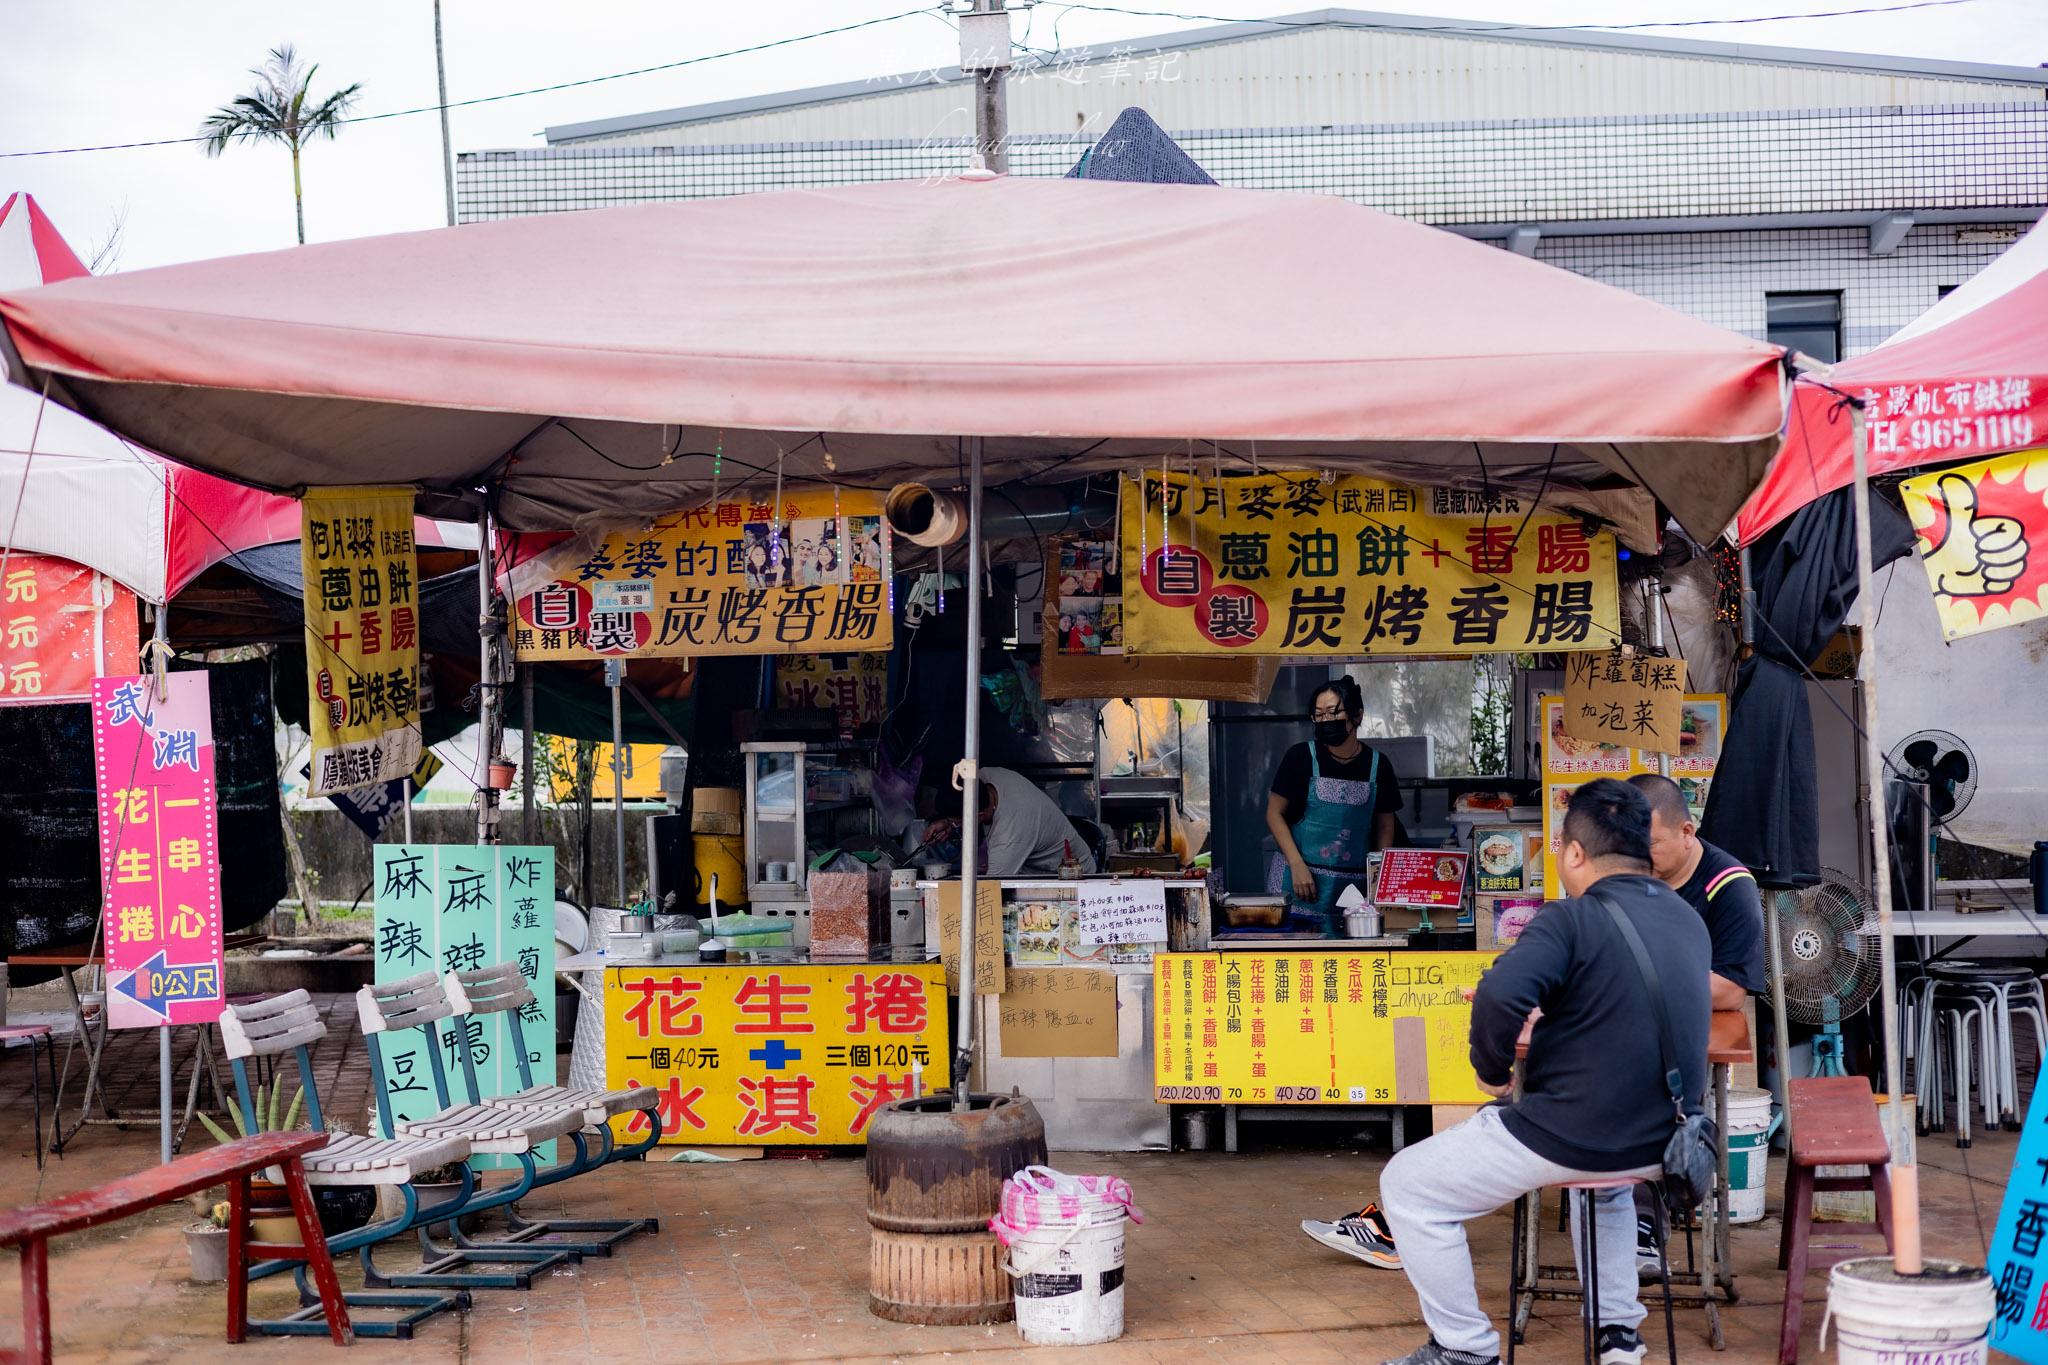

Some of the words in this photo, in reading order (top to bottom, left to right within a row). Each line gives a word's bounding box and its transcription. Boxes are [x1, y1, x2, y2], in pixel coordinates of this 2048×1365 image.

[1911, 414, 2032, 450] 9651119
[1146, 477, 1327, 521] 阿月婆婆
[1334, 488, 1416, 514] (武淵店)
[310, 515, 375, 560] 阿月婆婆
[319, 560, 412, 612] 蔥油餅
[1156, 550, 1259, 641] 自製
[0, 616, 39, 649] 元
[654, 583, 883, 647] 炭烤香腸
[1280, 580, 1594, 650] 炭烤香腸
[517, 628, 590, 651] 黑豬肉
[0, 662, 42, 694] 元
[1571, 651, 1683, 692] 炸蘿蔔糕
[105, 683, 200, 773] 武淵
[1581, 700, 1660, 738] 加泡菜
[1646, 757, 1715, 771] 花捲香腸
[112, 787, 156, 943] 花生捲
[163, 797, 207, 940] 一串心
[1226, 959, 1242, 1033] 大腸包小腸
[1274, 959, 1290, 1003] 蔥油餅
[1322, 958, 1339, 1003] 烤香腸
[1347, 958, 1363, 1003] 冬瓜茶
[1371, 958, 1389, 1018] 冬瓜檸檬
[624, 973, 928, 1039] 花生捲
[626, 1047, 719, 1070] 一個40元
[825, 1044, 930, 1072] 三個120元
[1227, 1088, 1242, 1098] 70
[1252, 1088, 1266, 1098] 75
[1277, 1086, 1293, 1101] 40
[1296, 1087, 1316, 1101] 50
[1326, 1088, 1340, 1099] 40
[1351, 1091, 1364, 1099] 35
[1374, 1088, 1389, 1099] 35
